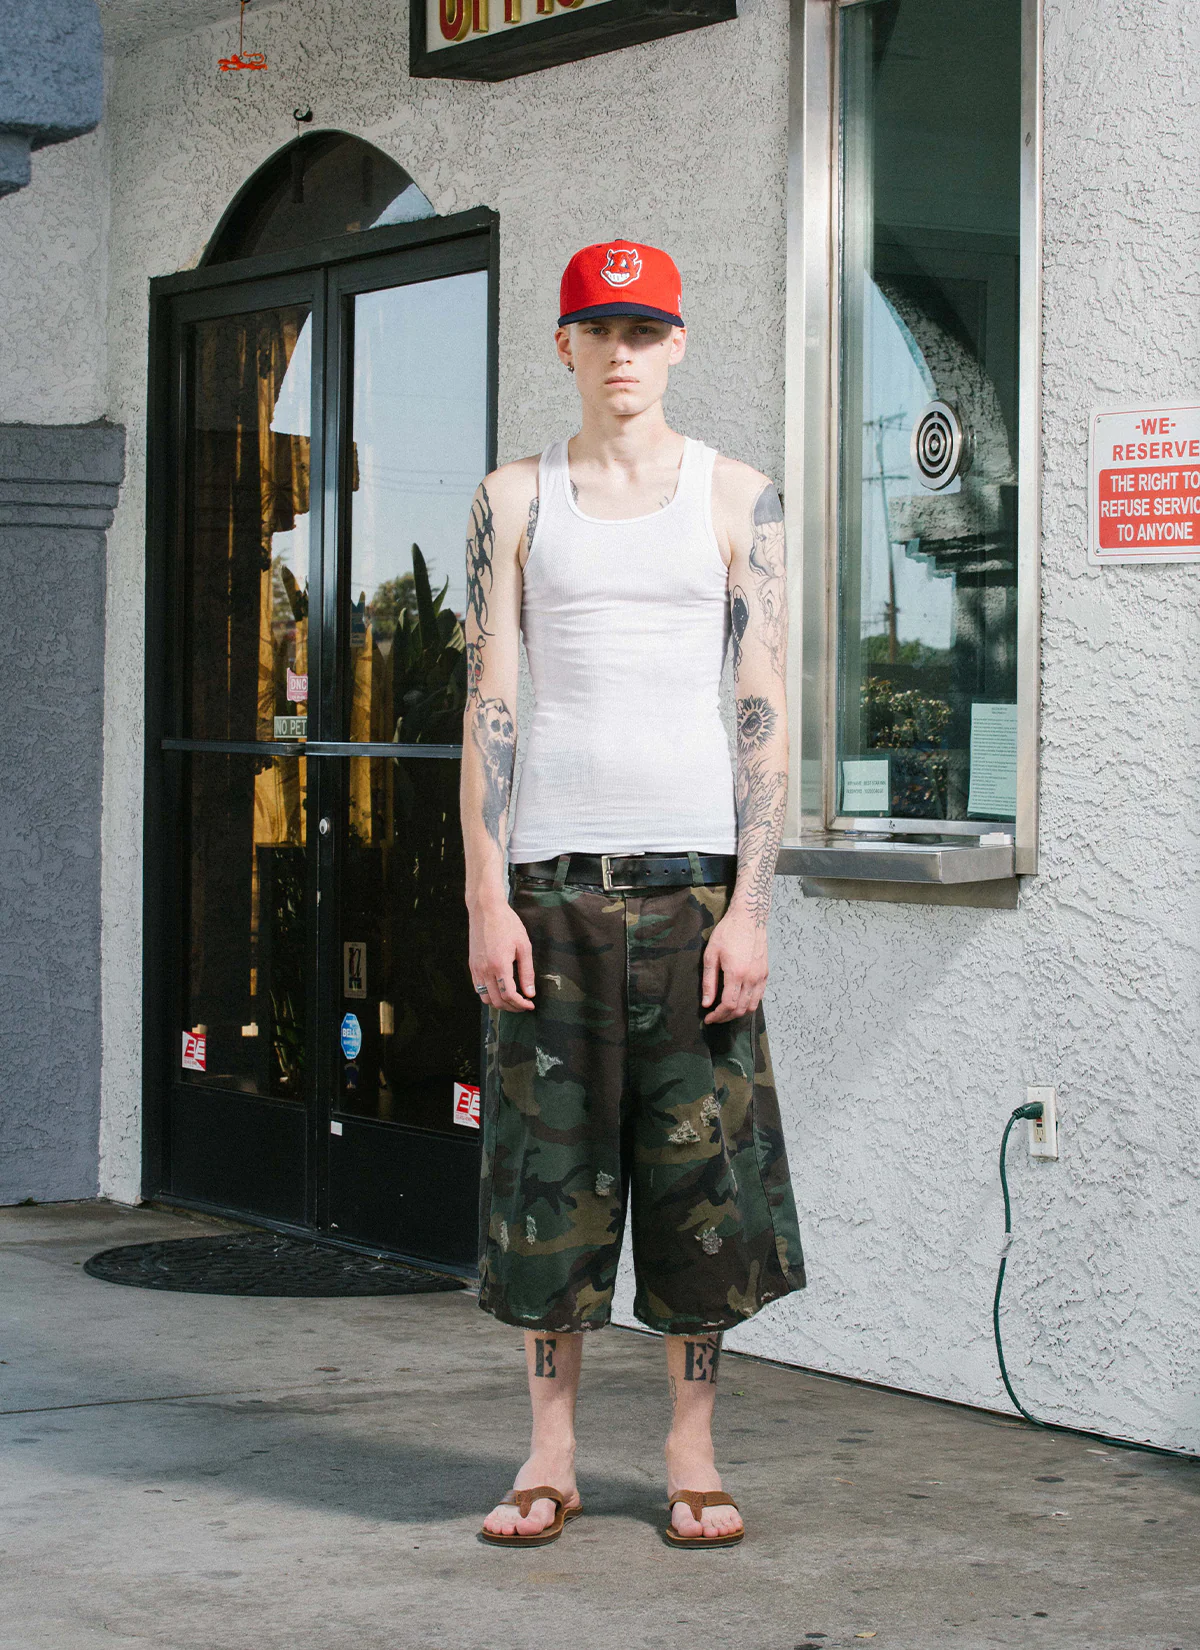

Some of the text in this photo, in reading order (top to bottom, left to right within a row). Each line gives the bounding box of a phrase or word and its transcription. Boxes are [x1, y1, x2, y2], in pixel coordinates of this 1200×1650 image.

[1112, 440, 1200, 462] RESERVE
[1110, 471, 1200, 493] THE RIGHT TO
[1101, 498, 1150, 518] REFUSE
[1117, 521, 1194, 542] TO ANYONE
[274, 720, 287, 735] NO
